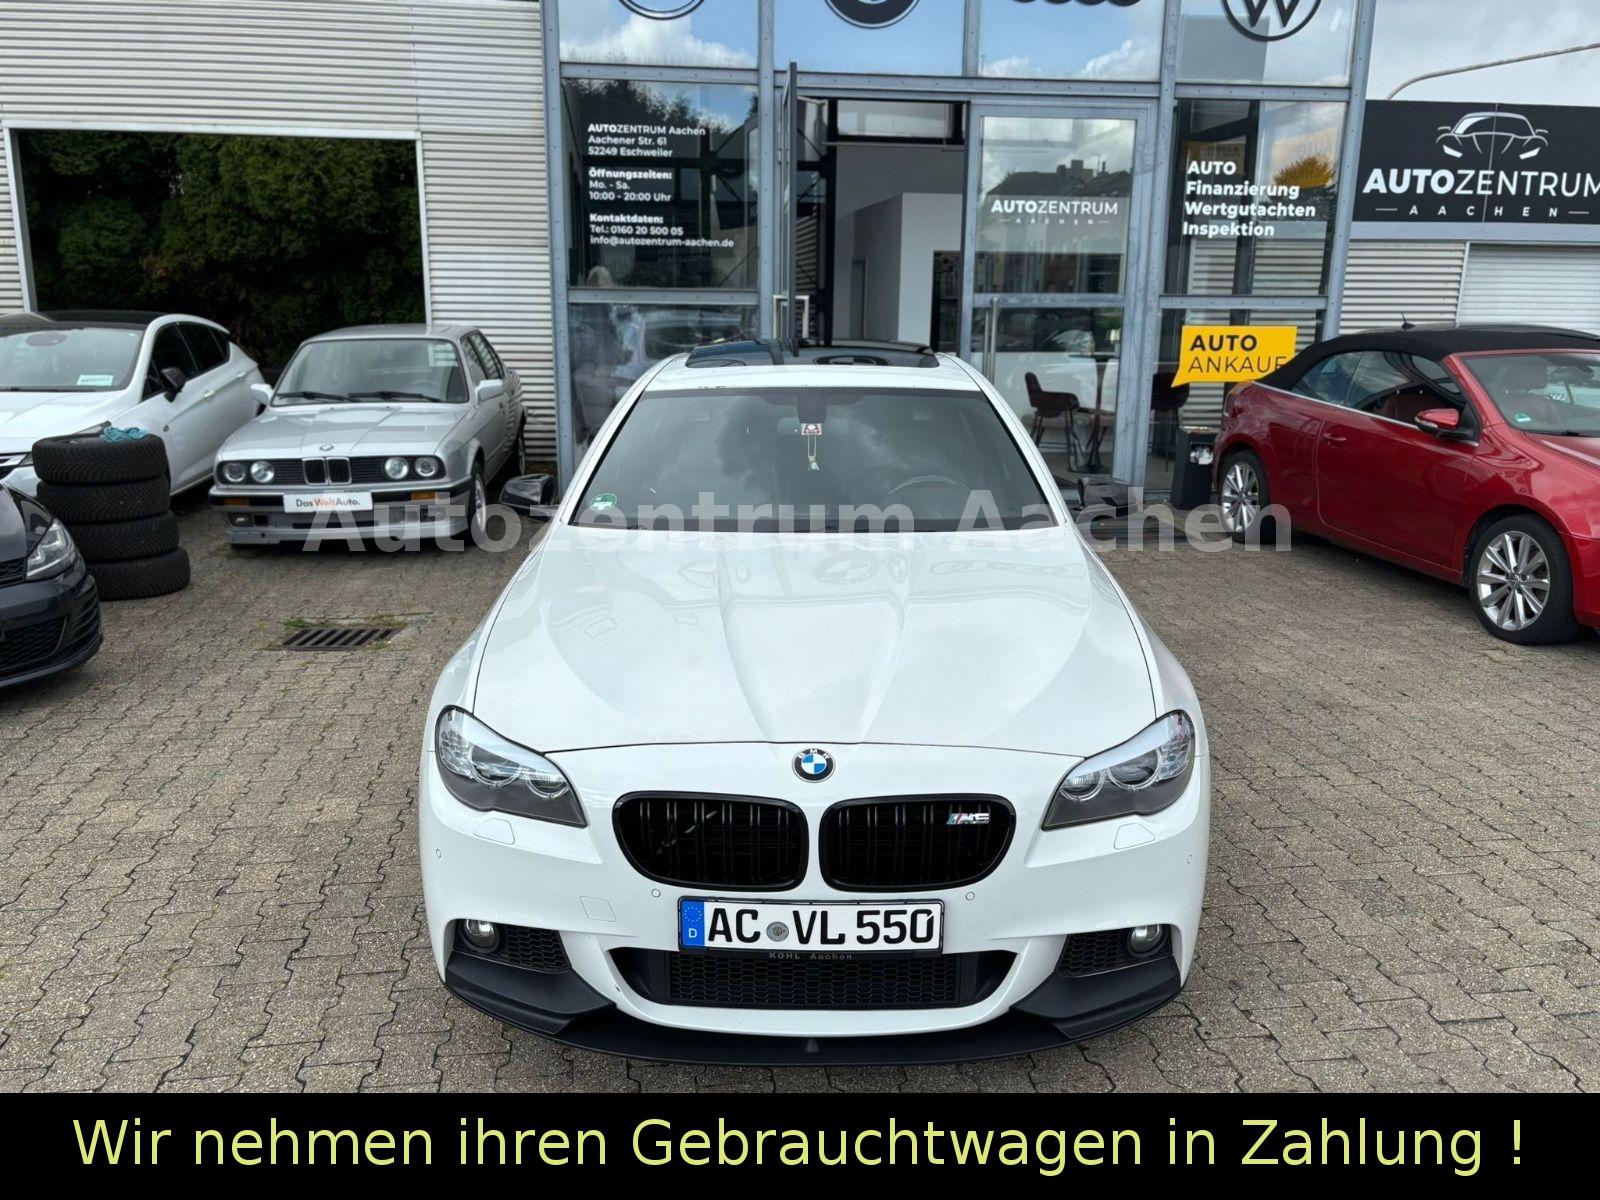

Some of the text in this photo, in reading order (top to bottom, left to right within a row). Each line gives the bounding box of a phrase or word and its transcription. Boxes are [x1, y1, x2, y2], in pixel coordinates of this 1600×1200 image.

[588, 124, 706, 136] AUTOZENTRUM Aachen
[588, 135, 667, 146] Aachener Str. 61
[588, 147, 673, 157] 52249 Eschweiler
[588, 167, 673, 180] Öffnungszeiten:
[1187, 160, 1237, 175] AUTO
[588, 181, 607, 189] Mo.
[615, 181, 631, 190] Sa.
[1186, 180, 1300, 200] Finanzierung
[589, 191, 615, 200] 10:00
[624, 192, 651, 201] 20:00
[653, 192, 672, 202] Uhr
[991, 200, 1118, 215] AUTOZENTRUM
[1184, 201, 1317, 219] Wertgutachten
[1409, 205, 1558, 217] AACHEN
[589, 213, 664, 224] Kontaktdaten:
[610, 225, 634, 235] 0160
[635, 226, 648, 235] 20
[649, 226, 669, 235] 500
[670, 226, 684, 236] 05
[1182, 221, 1275, 238] Inspektion
[590, 235, 734, 248] info@autozentrum-aachen.de
[1190, 334, 1258, 352] AUTO
[707, 907, 761, 944] AC
[792, 909, 846, 945] VL
[856, 908, 934, 945] 550
